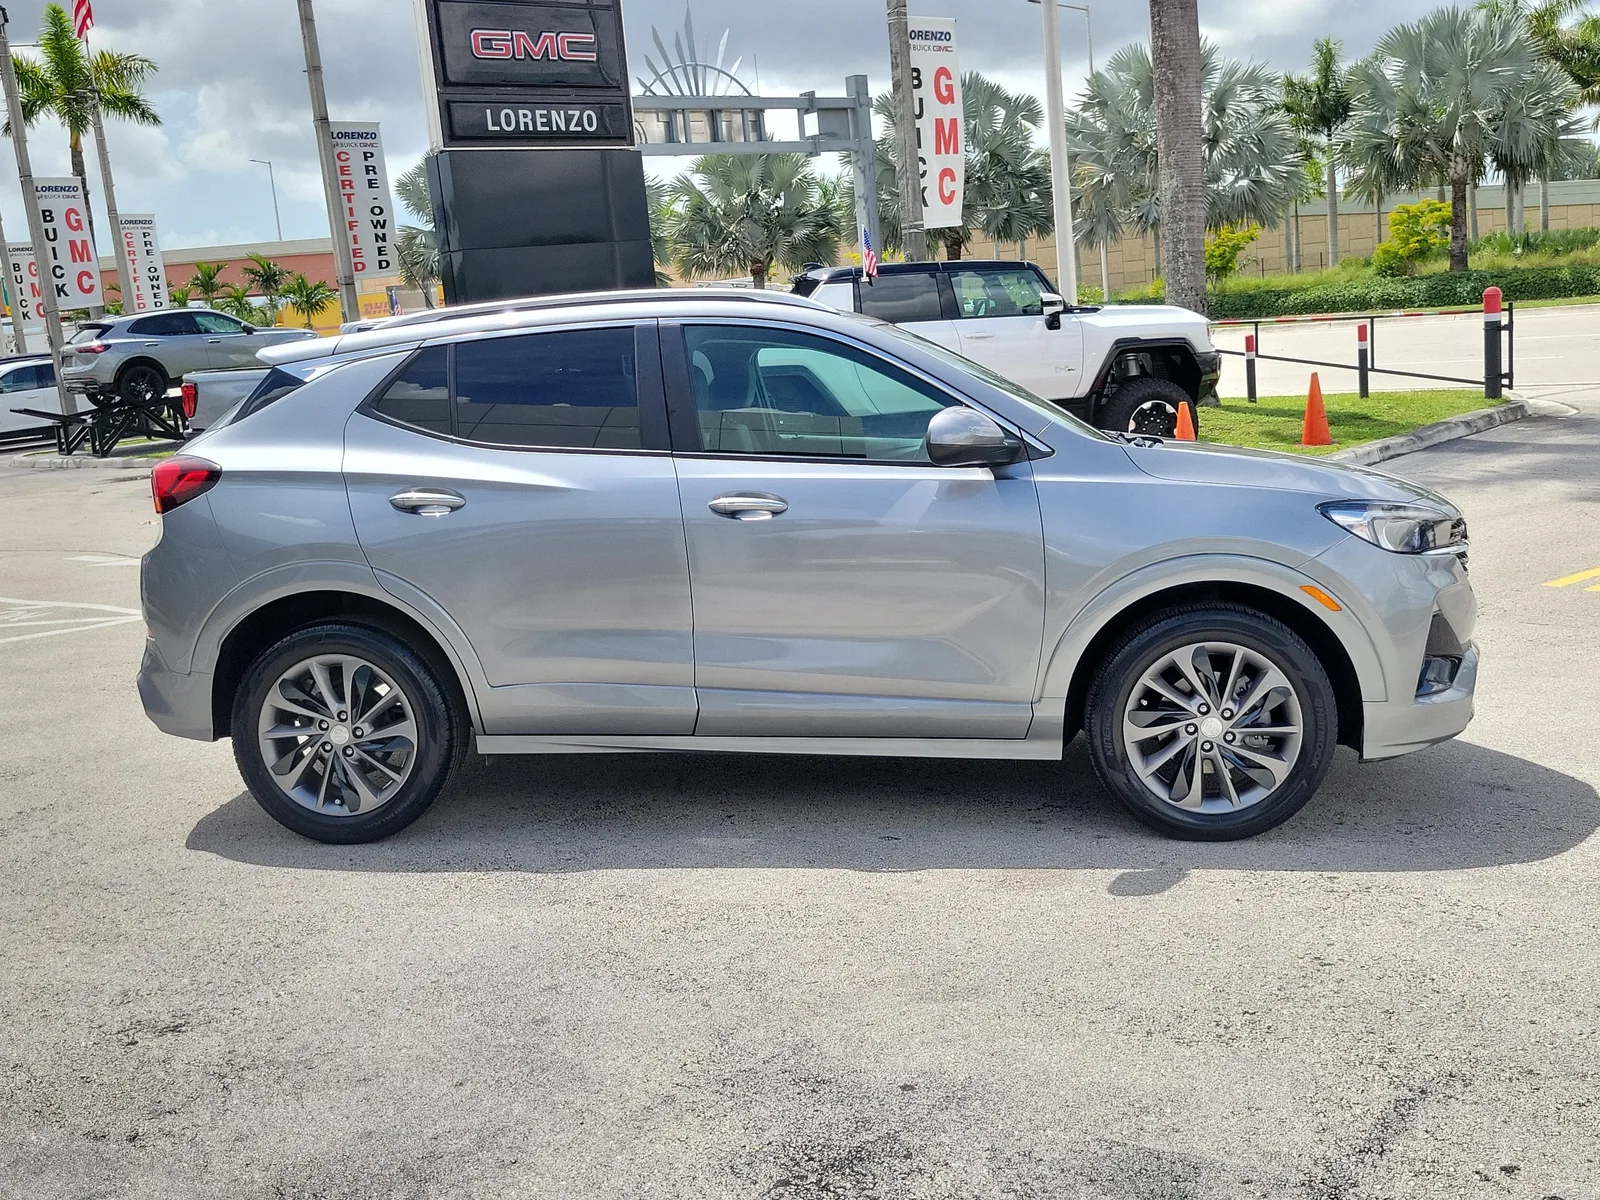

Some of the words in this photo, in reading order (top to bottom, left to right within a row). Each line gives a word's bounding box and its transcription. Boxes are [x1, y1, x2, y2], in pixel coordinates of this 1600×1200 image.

[471, 28, 597, 61] GMC
[909, 29, 952, 42] ORENZO
[912, 44, 932, 52] BUICK
[932, 45, 954, 53] GMC
[331, 131, 377, 140] LORENZO
[486, 108, 597, 132] LORENZO
[911, 67, 930, 208] BUICK
[934, 66, 959, 206] GMC
[35, 185, 79, 193] LORENZO
[336, 151, 367, 273] CERTIFIED
[363, 151, 391, 270] PRE-OWNED
[41, 209, 70, 298] BUICK
[65, 207, 96, 295] GMC
[124, 232, 146, 310] CERTIFIED
[143, 232, 163, 308] PRE-OWNED
[12, 262, 31, 320] BUICK
